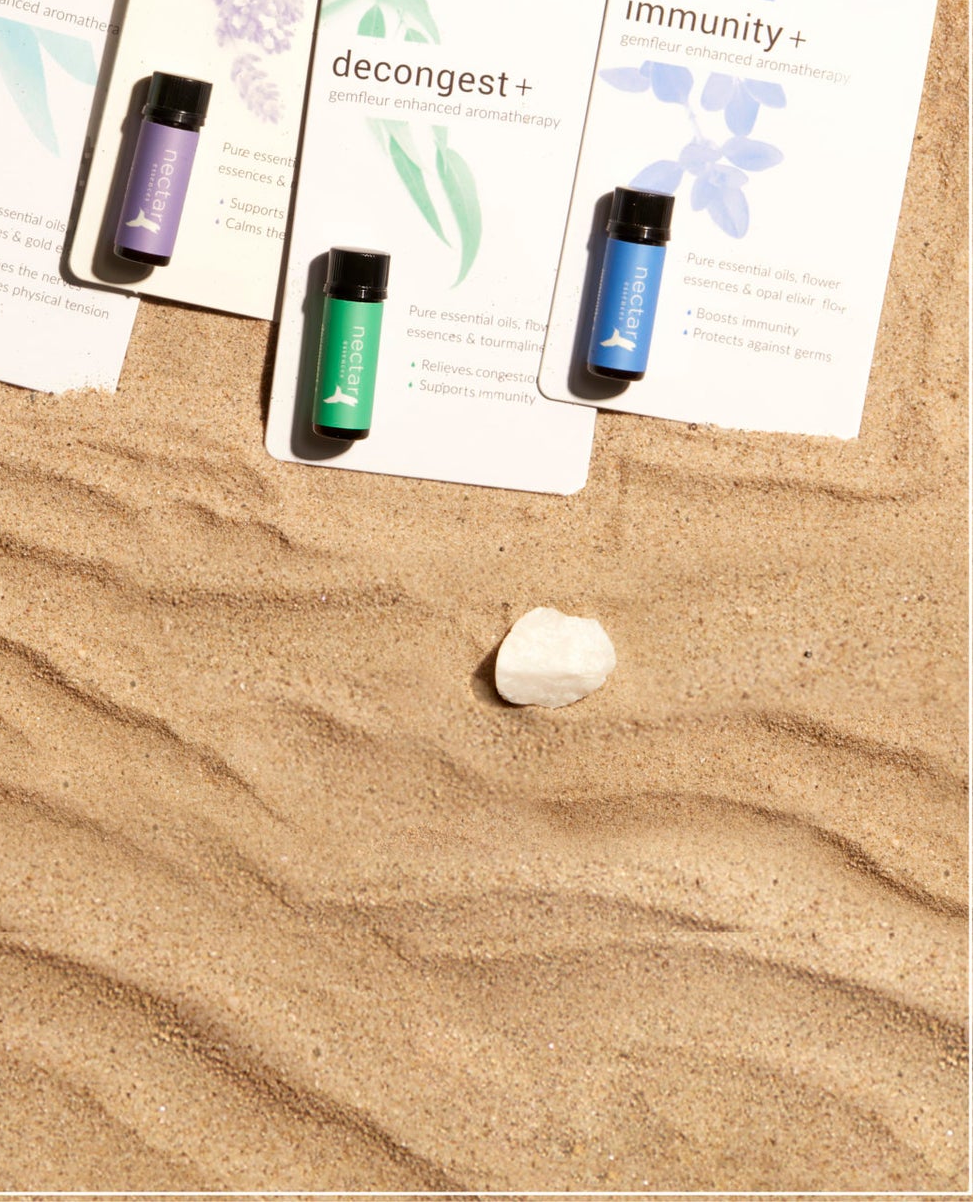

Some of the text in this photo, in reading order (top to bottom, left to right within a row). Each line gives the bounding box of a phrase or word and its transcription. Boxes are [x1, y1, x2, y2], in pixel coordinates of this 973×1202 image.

[43, 4, 120, 35] aromathera
[620, 33, 851, 84] gemfleur enhanced aromatherapy
[328, 89, 560, 130] gemfleur enhanced aromatherapy
[223, 142, 295, 168] Pure essenti
[152, 149, 177, 223] nectar
[218, 164, 286, 187] essences &
[230, 198, 285, 219] Supports
[12, 231, 21, 242] &
[24, 234, 52, 250] gold
[225, 218, 262, 235] Calms
[19, 263, 38, 279] the
[687, 252, 715, 268] Pure
[718, 260, 771, 278] essential
[802, 272, 841, 290] flower
[12, 285, 61, 309] physical
[65, 299, 109, 319] tension
[626, 265, 648, 340] nectar
[683, 274, 738, 293] essences
[742, 284, 751, 295] &
[756, 287, 784, 302] opal
[786, 291, 815, 306] elixir
[409, 305, 437, 319] Pure
[440, 312, 493, 326] essential
[696, 307, 800, 337] Boosts immunity
[407, 327, 462, 343] essences
[466, 333, 475, 344] &
[693, 328, 832, 362] Protects against germs
[347, 325, 365, 396] nectar
[476, 363, 536, 384] congestio
[419, 379, 536, 406] Supports immunity
